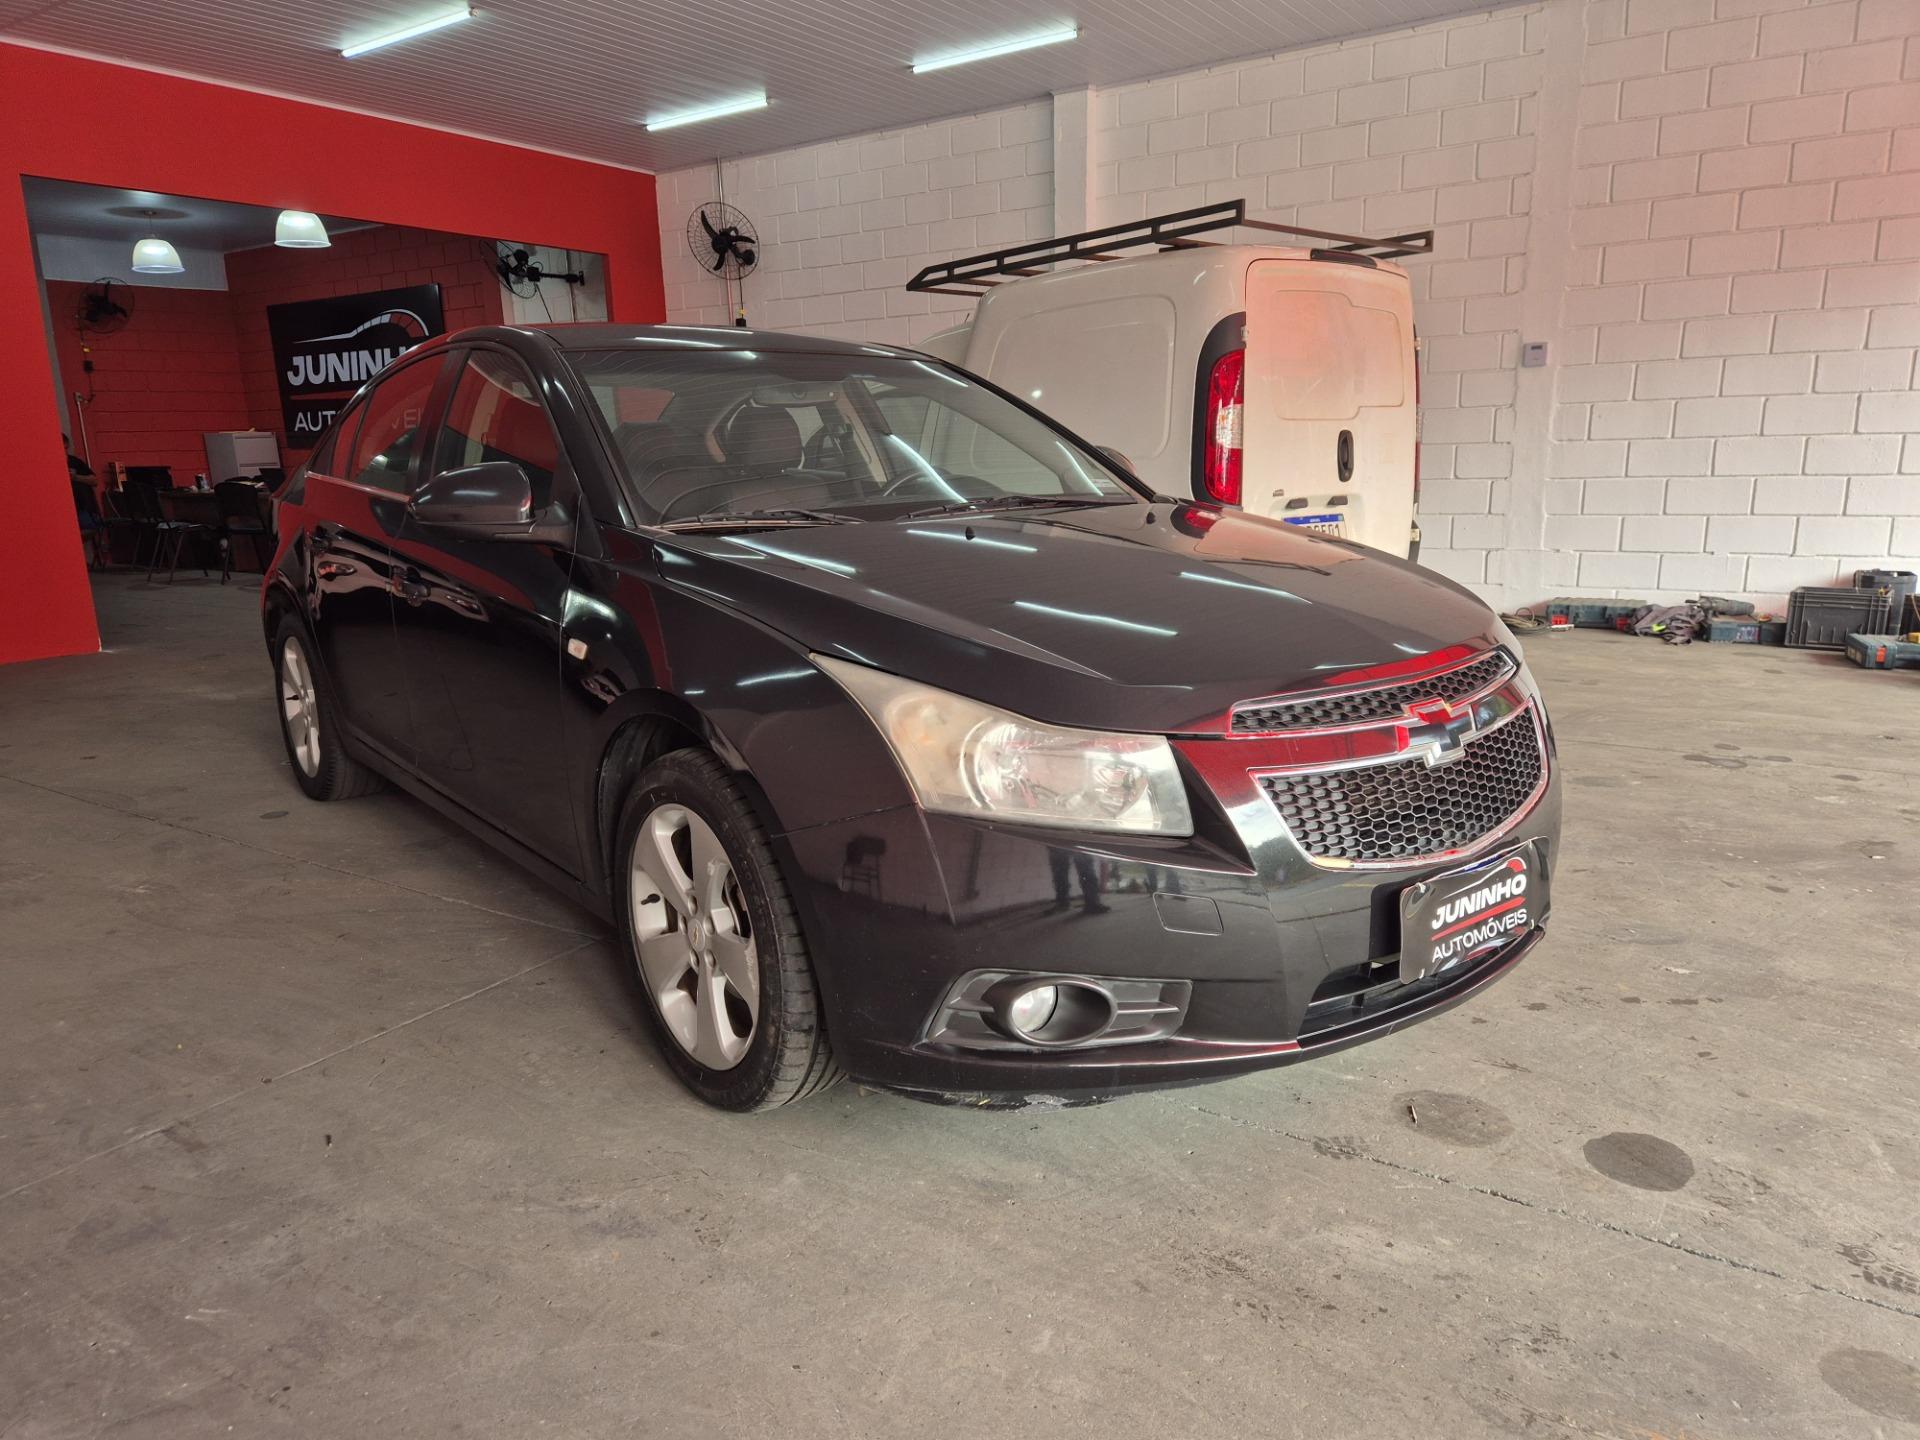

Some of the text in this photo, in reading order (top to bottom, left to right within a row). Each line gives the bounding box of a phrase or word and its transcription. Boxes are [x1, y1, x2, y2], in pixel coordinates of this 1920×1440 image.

[287, 346, 407, 386] JUNIN
[1431, 874, 1527, 930] JUNINHO
[1431, 908, 1528, 963] AUTOMÓVEIS
